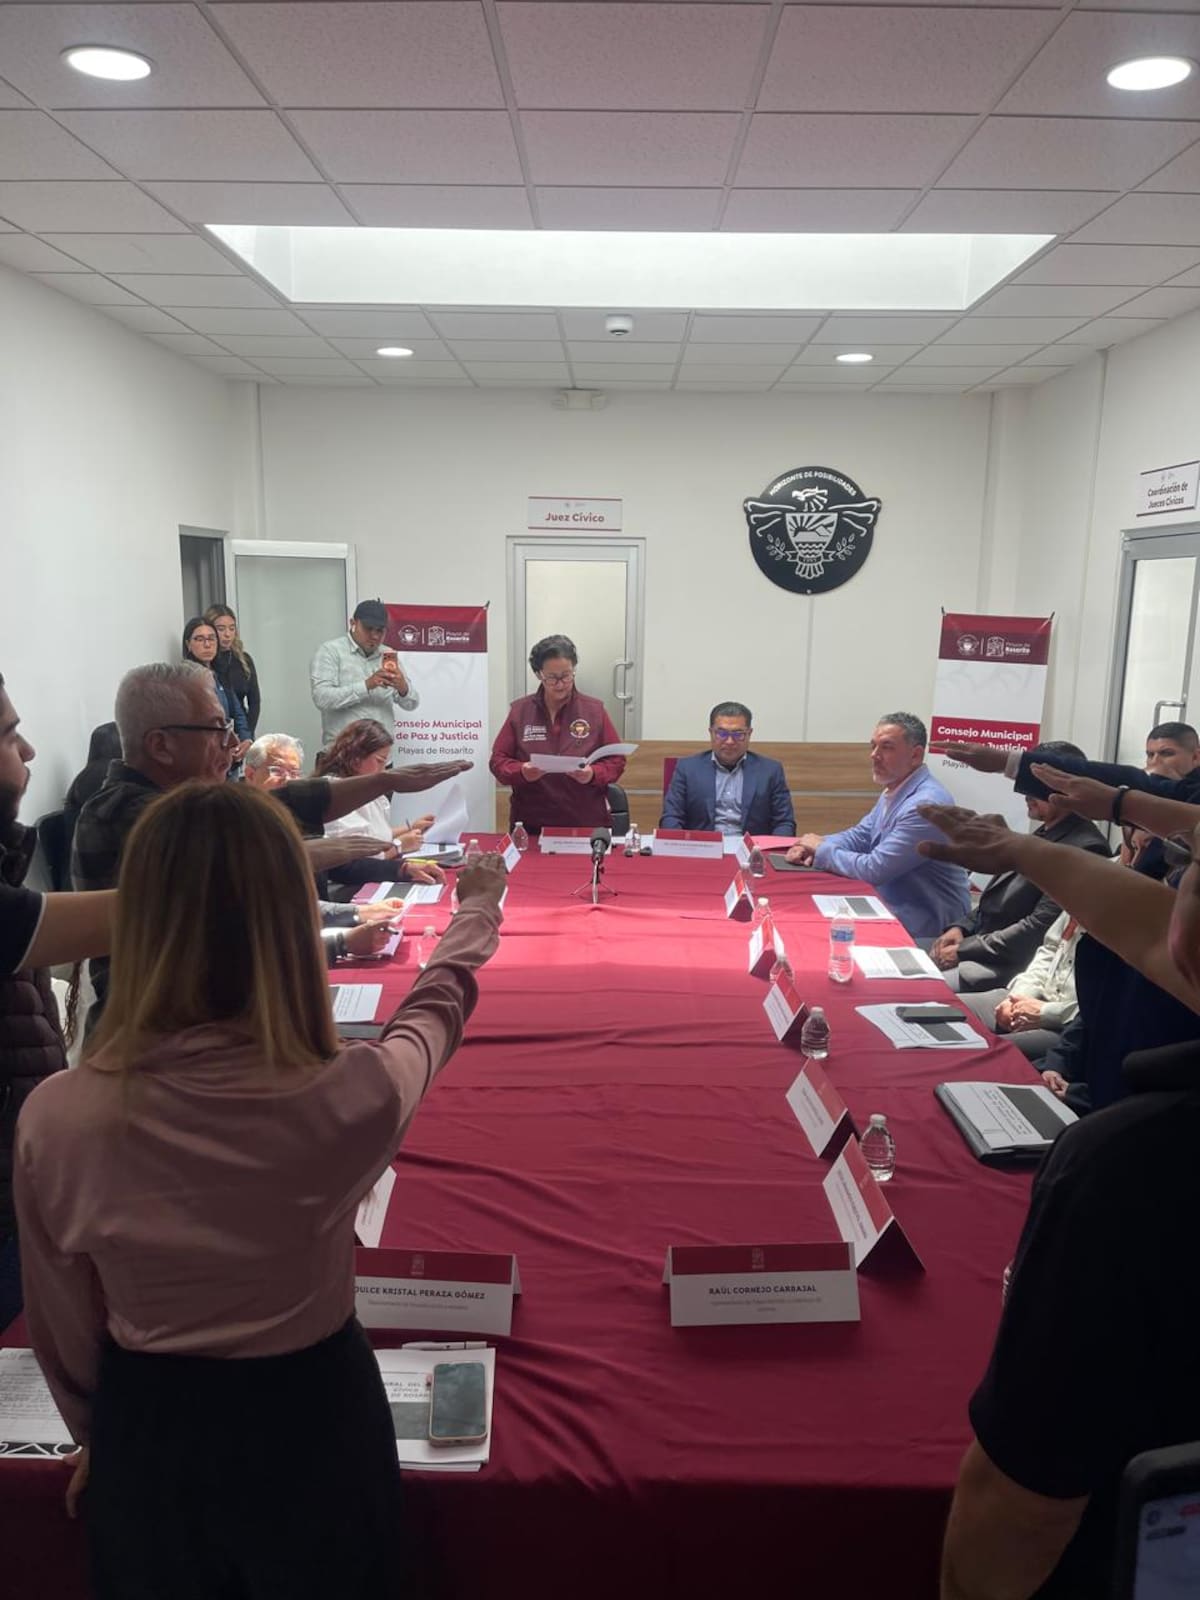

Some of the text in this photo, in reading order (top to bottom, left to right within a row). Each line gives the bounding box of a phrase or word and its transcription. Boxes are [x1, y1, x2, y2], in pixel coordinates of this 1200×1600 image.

[769, 471, 857, 497] HORIZONTE DE POSIBILIDADES
[1181, 480, 1188, 491] de
[545, 511, 605, 523] Juez Cívico
[432, 719, 482, 732] Municipal
[395, 731, 479, 743] de Paz y Justicia
[937, 725, 979, 738] Consejo
[980, 729, 1034, 742] Municipal
[398, 745, 474, 756] Playas de Rosarito
[382, 1288, 417, 1297] KRISTAL
[419, 1289, 453, 1298] PERAZA
[454, 1289, 486, 1300] GÓMEZ
[709, 1286, 731, 1295] RAÚL
[733, 1285, 772, 1294] CORNEJO
